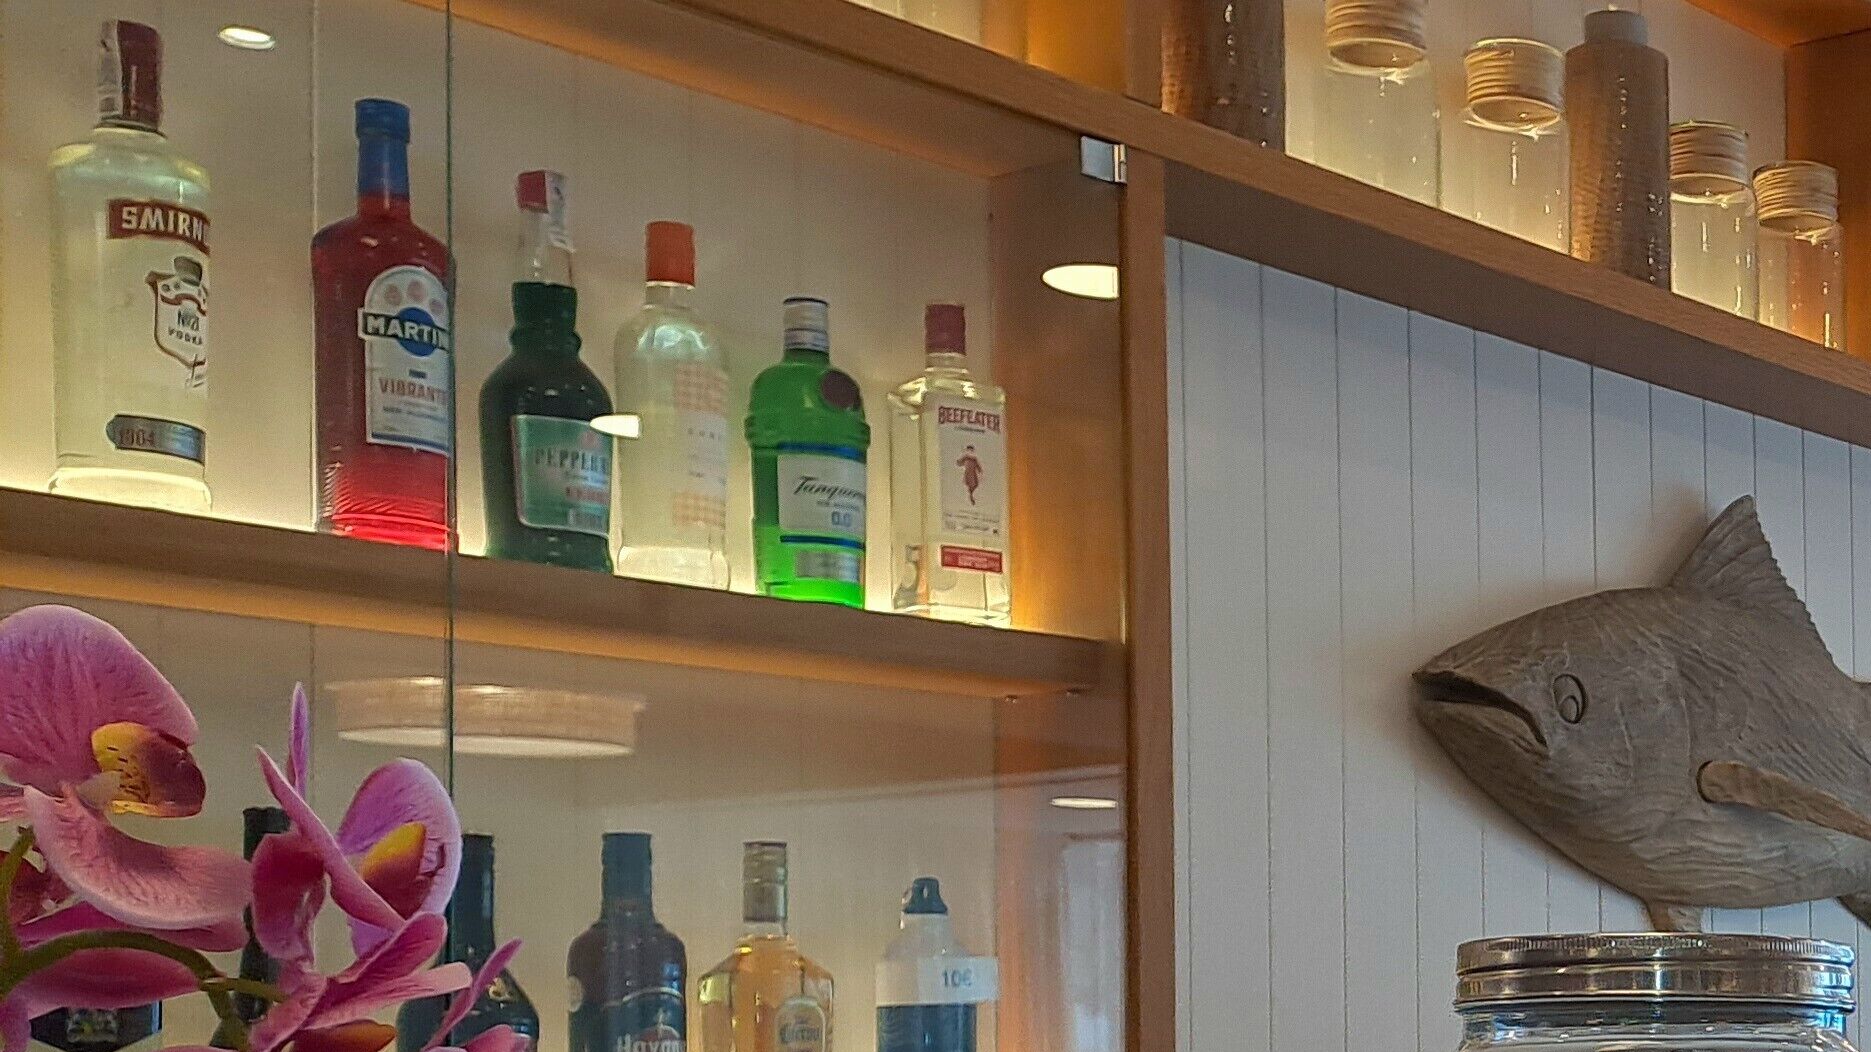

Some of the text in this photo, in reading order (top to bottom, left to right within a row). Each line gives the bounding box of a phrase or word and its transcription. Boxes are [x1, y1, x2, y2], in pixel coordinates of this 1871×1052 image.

[121, 205, 205, 242] SMIRN
[937, 405, 1000, 433] BEEFEATER
[792, 474, 866, 501] Tanqu
